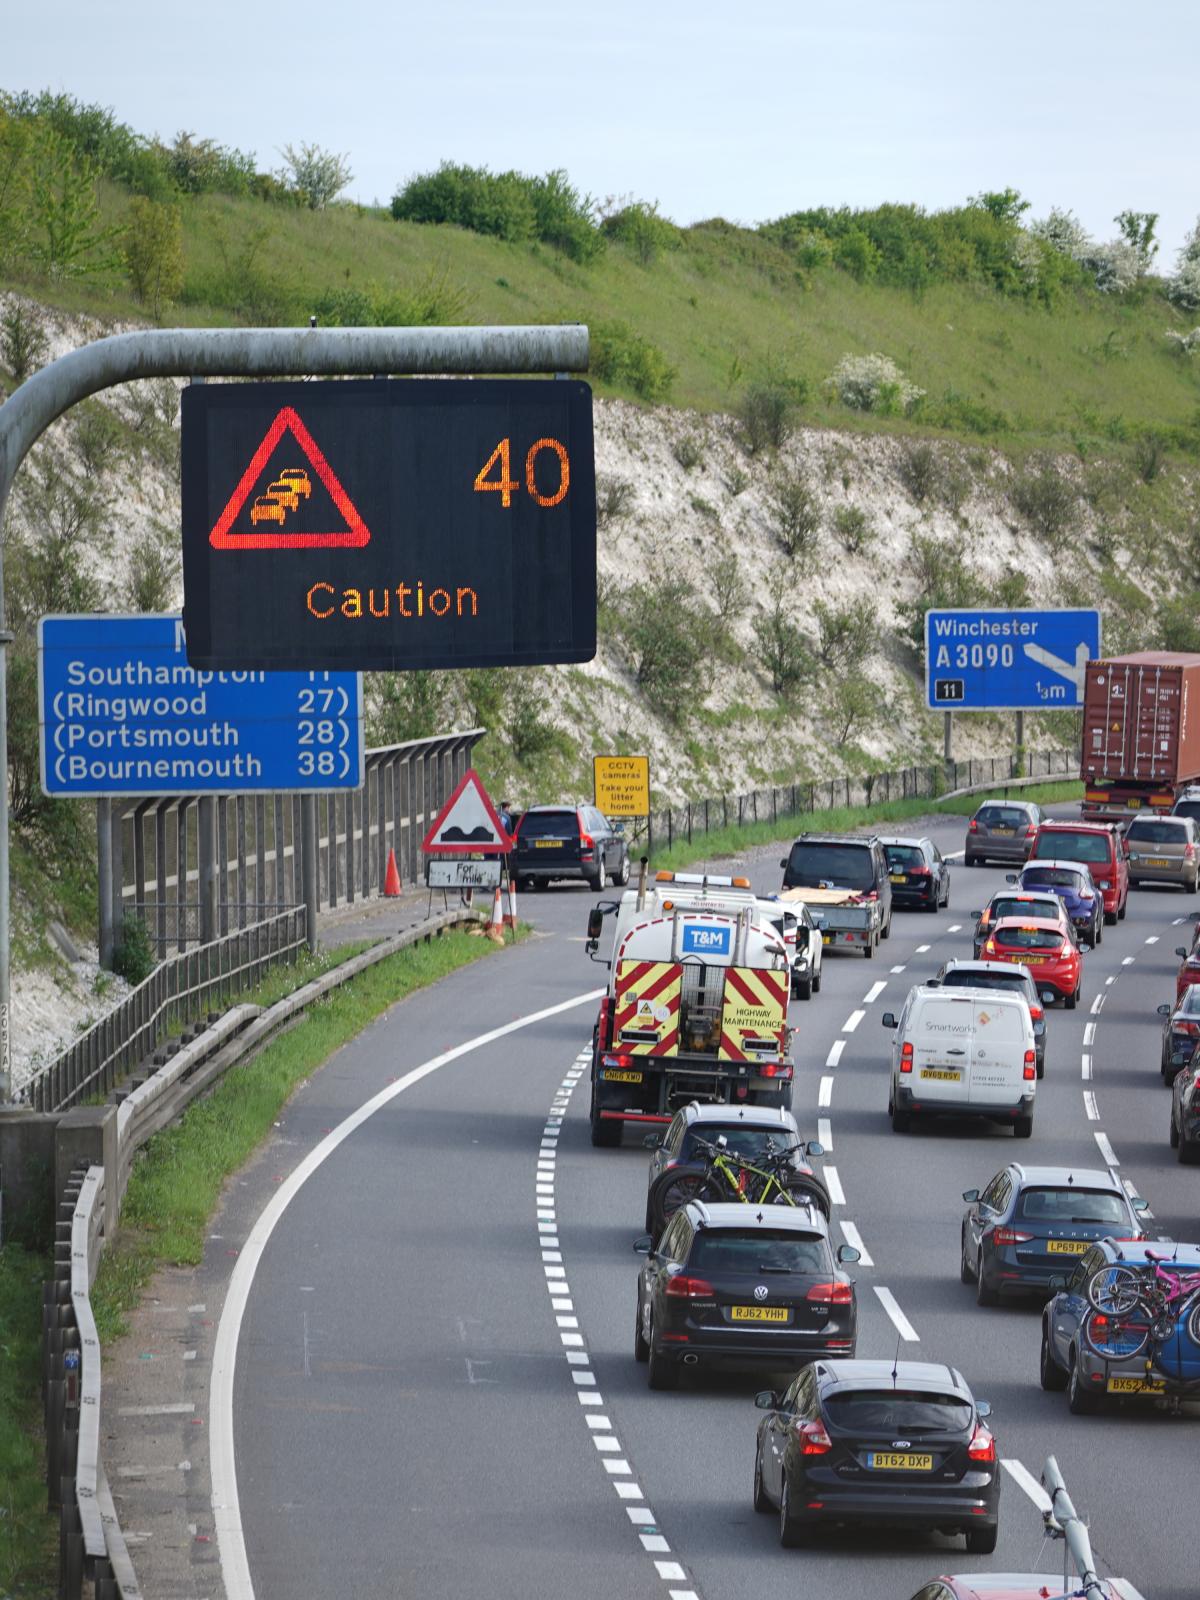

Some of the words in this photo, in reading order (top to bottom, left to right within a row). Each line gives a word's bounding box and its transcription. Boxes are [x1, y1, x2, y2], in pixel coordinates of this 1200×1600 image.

[474, 437, 570, 507] 40
[306, 581, 478, 619] Caution
[934, 619, 1039, 636] Winchester
[67, 660, 265, 688] Southampton
[943, 683, 957, 697] 11
[53, 691, 206, 721] (Ringwood
[298, 686, 349, 717] 27)
[54, 722, 239, 752] (Portsmouth
[298, 718, 350, 748] 28)
[54, 753, 262, 783] (Bournemouth
[298, 750, 350, 779] 38)
[608, 762, 635, 770] CCTV
[624, 785, 644, 793] your
[611, 793, 634, 801] litter
[610, 802, 635, 811] home
[456, 863, 473, 876] For
[691, 930, 723, 945] T&M
[736, 1008, 772, 1018] HIGHWAY
[724, 1017, 782, 1029] MAINTENANCE
[1050, 1242, 1074, 1253] LP69
[736, 1307, 762, 1319] RJ62
[762, 1308, 784, 1321] YHH
[875, 1454, 905, 1466] BT62
[908, 1455, 930, 1468] DXP
